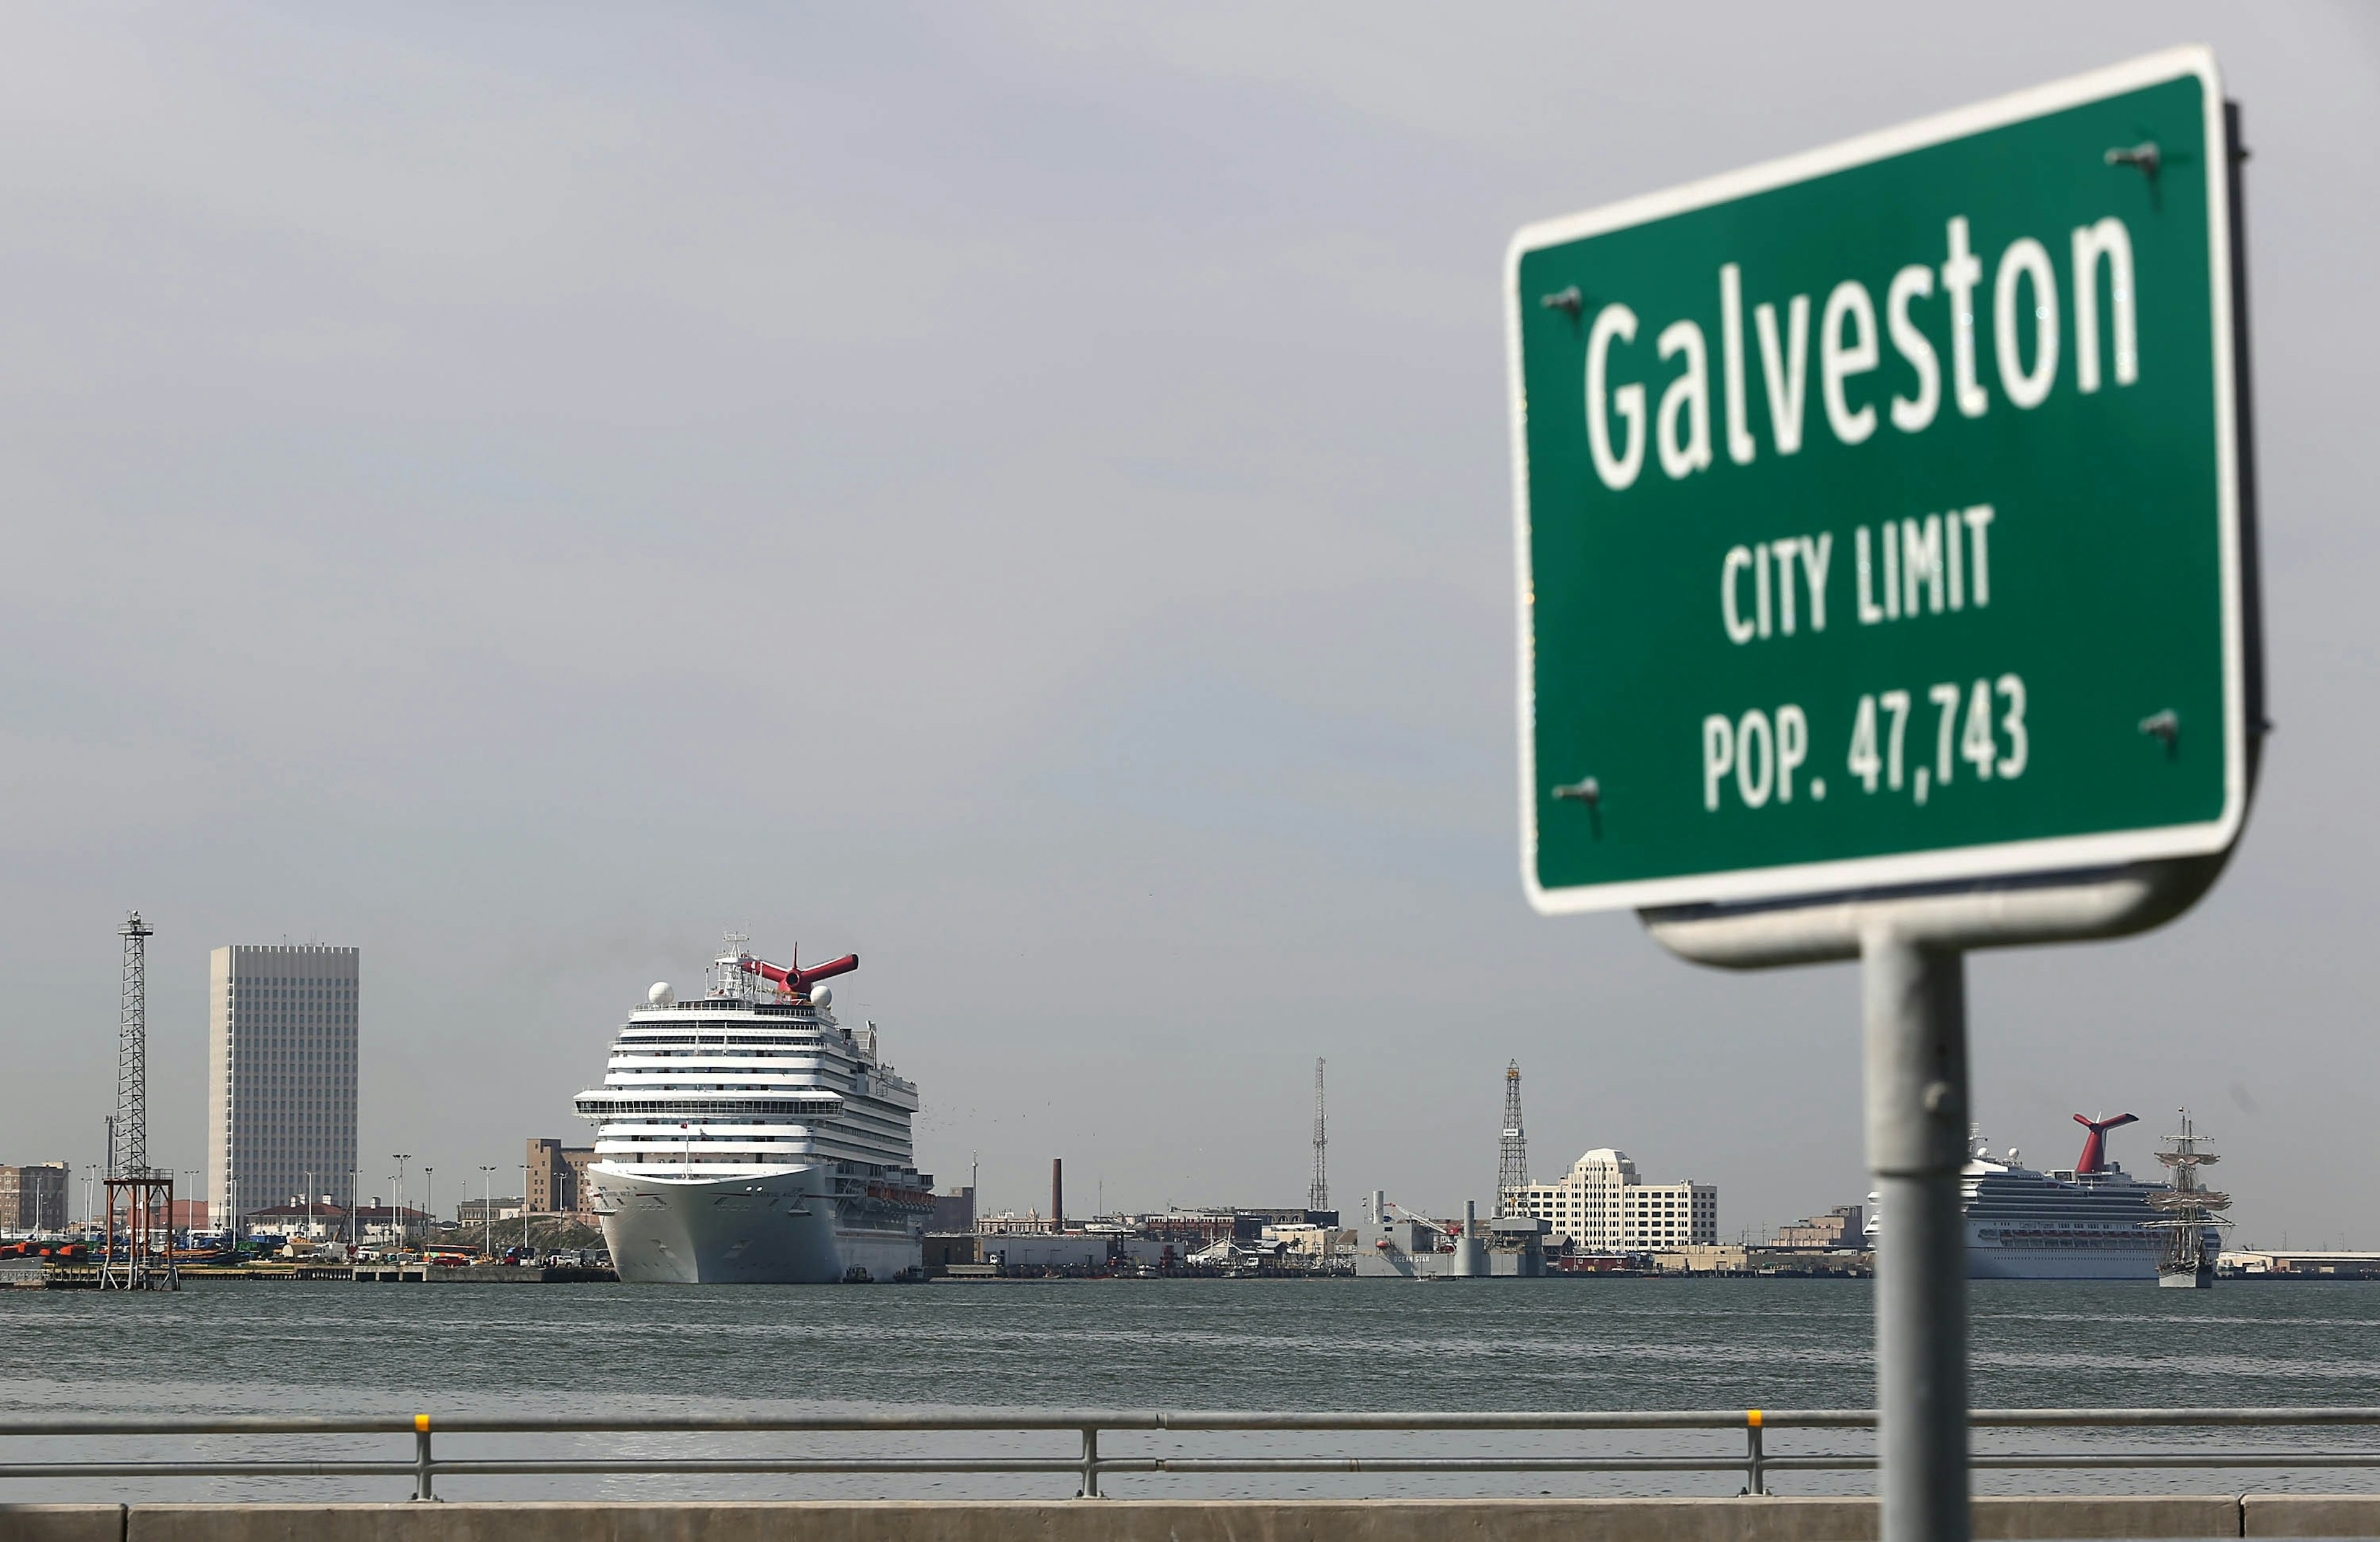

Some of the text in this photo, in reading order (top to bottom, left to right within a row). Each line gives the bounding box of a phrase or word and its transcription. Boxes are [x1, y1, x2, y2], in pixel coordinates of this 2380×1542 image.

[1585, 216, 2138, 490] Galveston
[1722, 504, 1995, 643] CITY LIMIT
[1703, 675, 2027, 809] POP. 47,743
